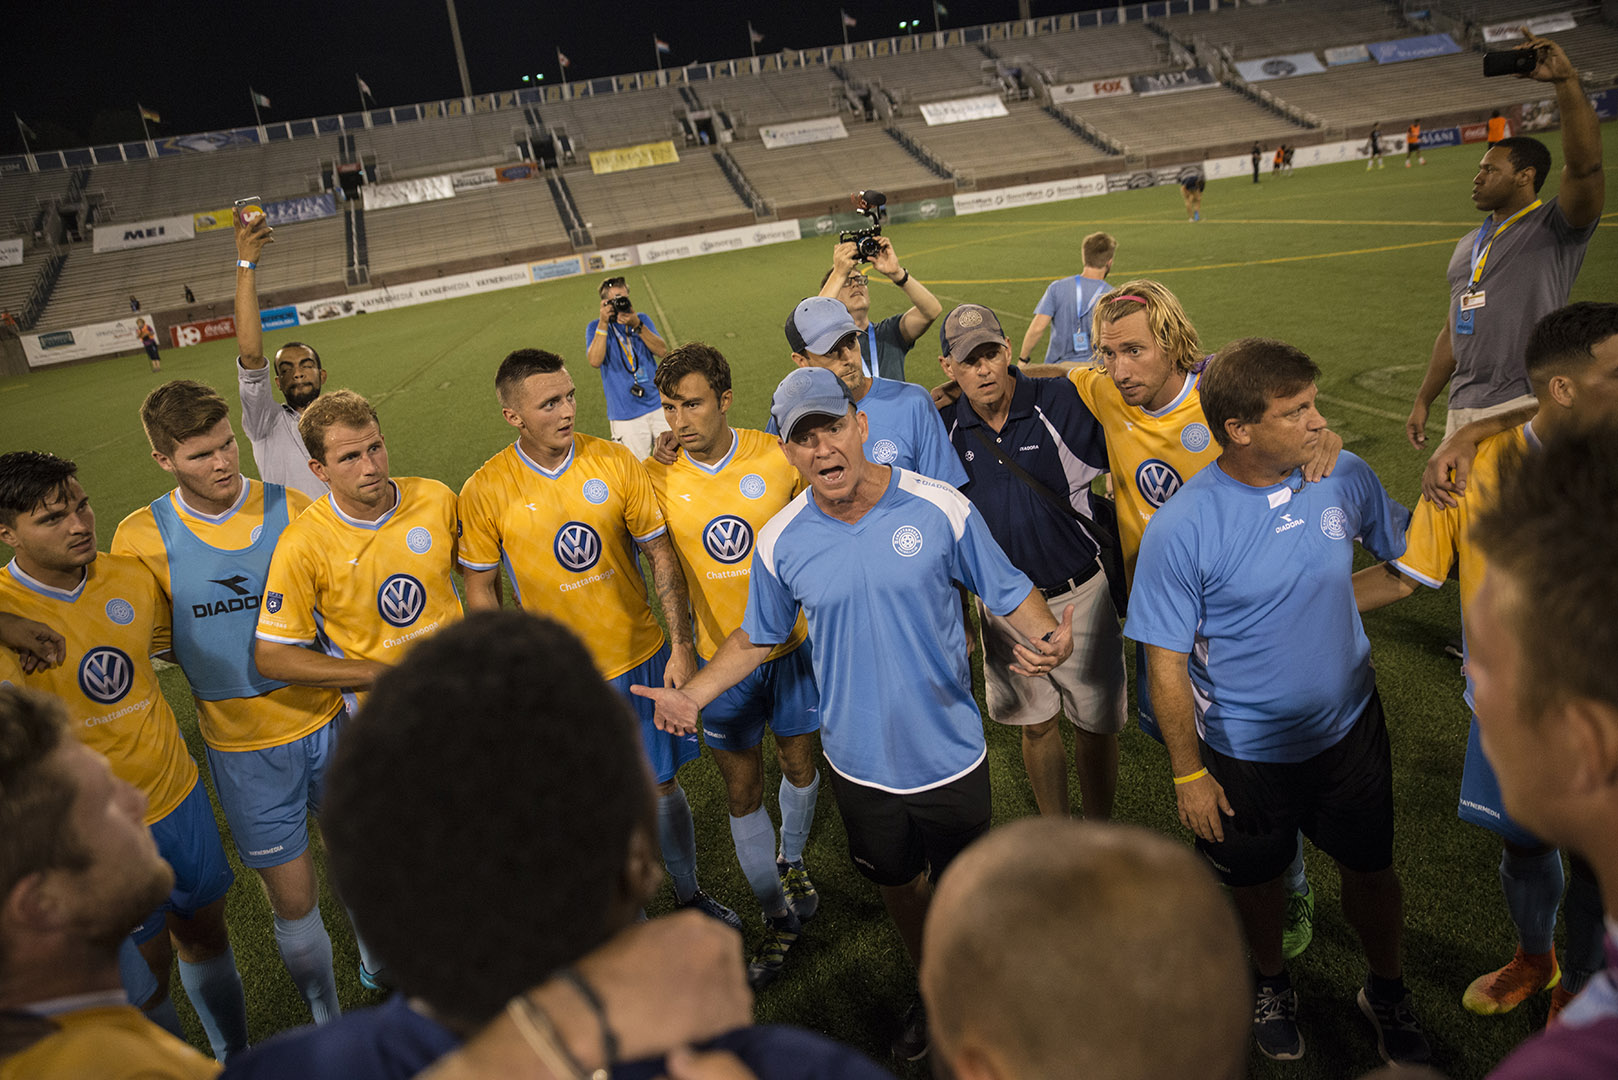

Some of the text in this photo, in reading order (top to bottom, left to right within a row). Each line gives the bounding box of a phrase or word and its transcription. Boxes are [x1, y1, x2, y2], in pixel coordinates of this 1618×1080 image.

[618, 69, 683, 91] THE
[1093, 80, 1123, 95] FOX
[124, 226, 165, 241] MEI
[1019, 444, 1040, 452] DIADORA
[1275, 518, 1305, 534] DIADORA
[558, 525, 598, 569] VW
[707, 518, 750, 561] VW
[559, 568, 615, 593] Chattanooga
[192, 595, 262, 618] DIADO
[381, 577, 423, 624] VW
[383, 621, 440, 650] Chattanooga
[83, 651, 130, 700] VW
[85, 698, 151, 728] Chattanooga
